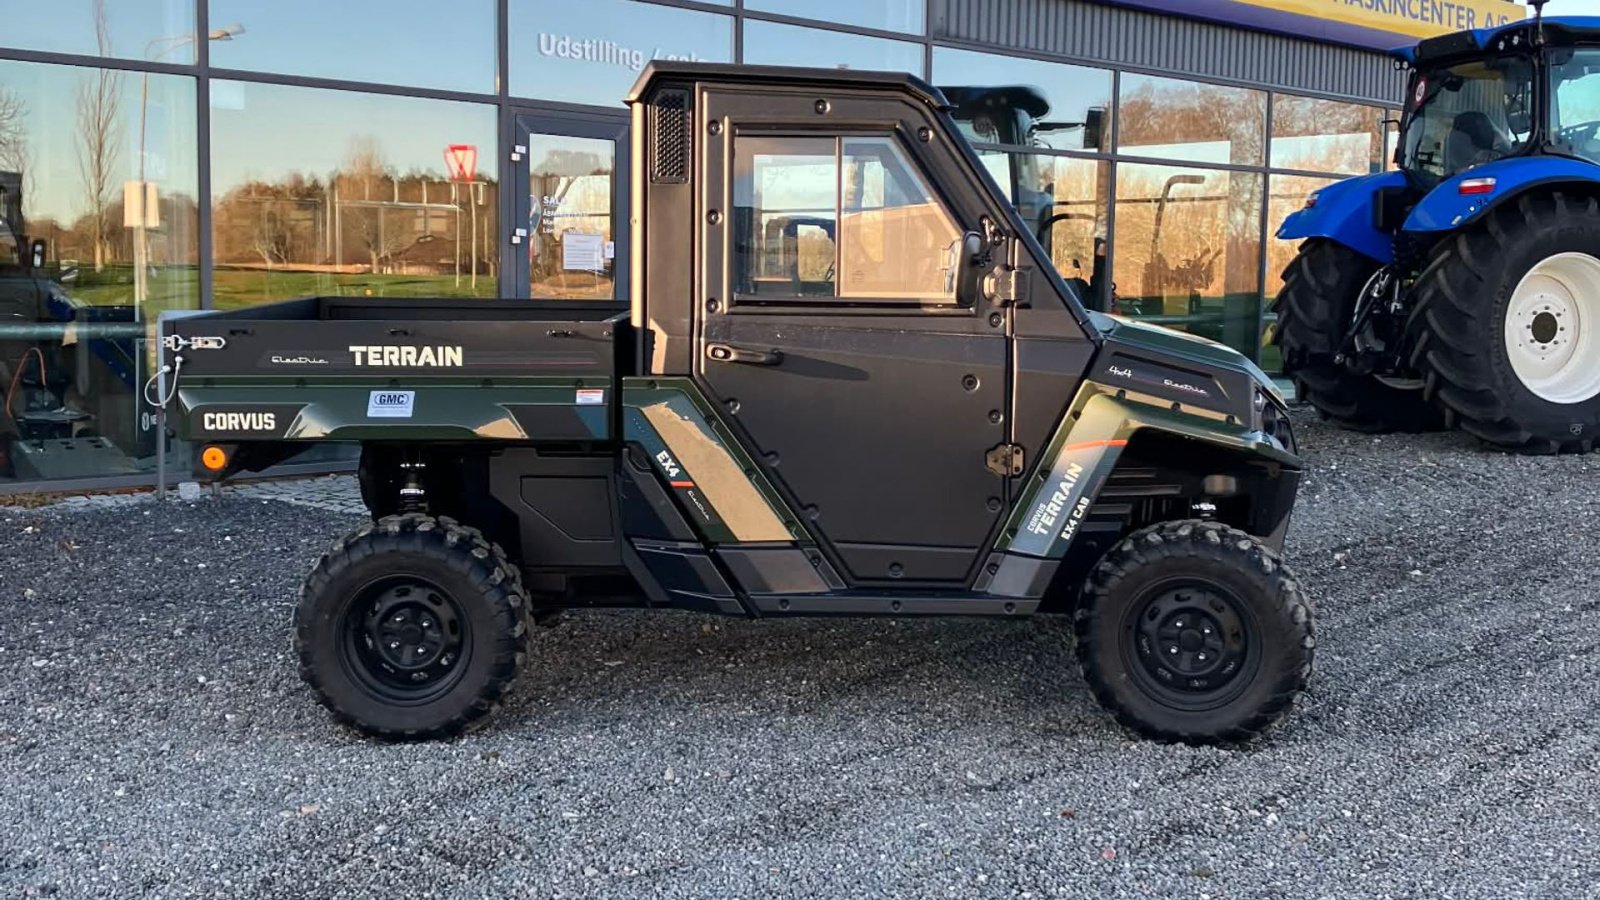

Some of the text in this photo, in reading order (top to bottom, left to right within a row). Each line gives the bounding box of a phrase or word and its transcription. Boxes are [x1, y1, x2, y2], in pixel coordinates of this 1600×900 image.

[1332, 0, 1476, 30] KINCENTER
[538, 32, 644, 71] Udstilling
[349, 345, 463, 367] TERRAIN
[1108, 365, 1133, 379] 4x4
[379, 394, 405, 405] GMC
[203, 412, 276, 431] CORVUS
[655, 449, 681, 478] EX4
[1033, 462, 1084, 535] TERRAIN
[1026, 502, 1047, 532] CORVUS
[1060, 496, 1091, 540] EX4 CAB
